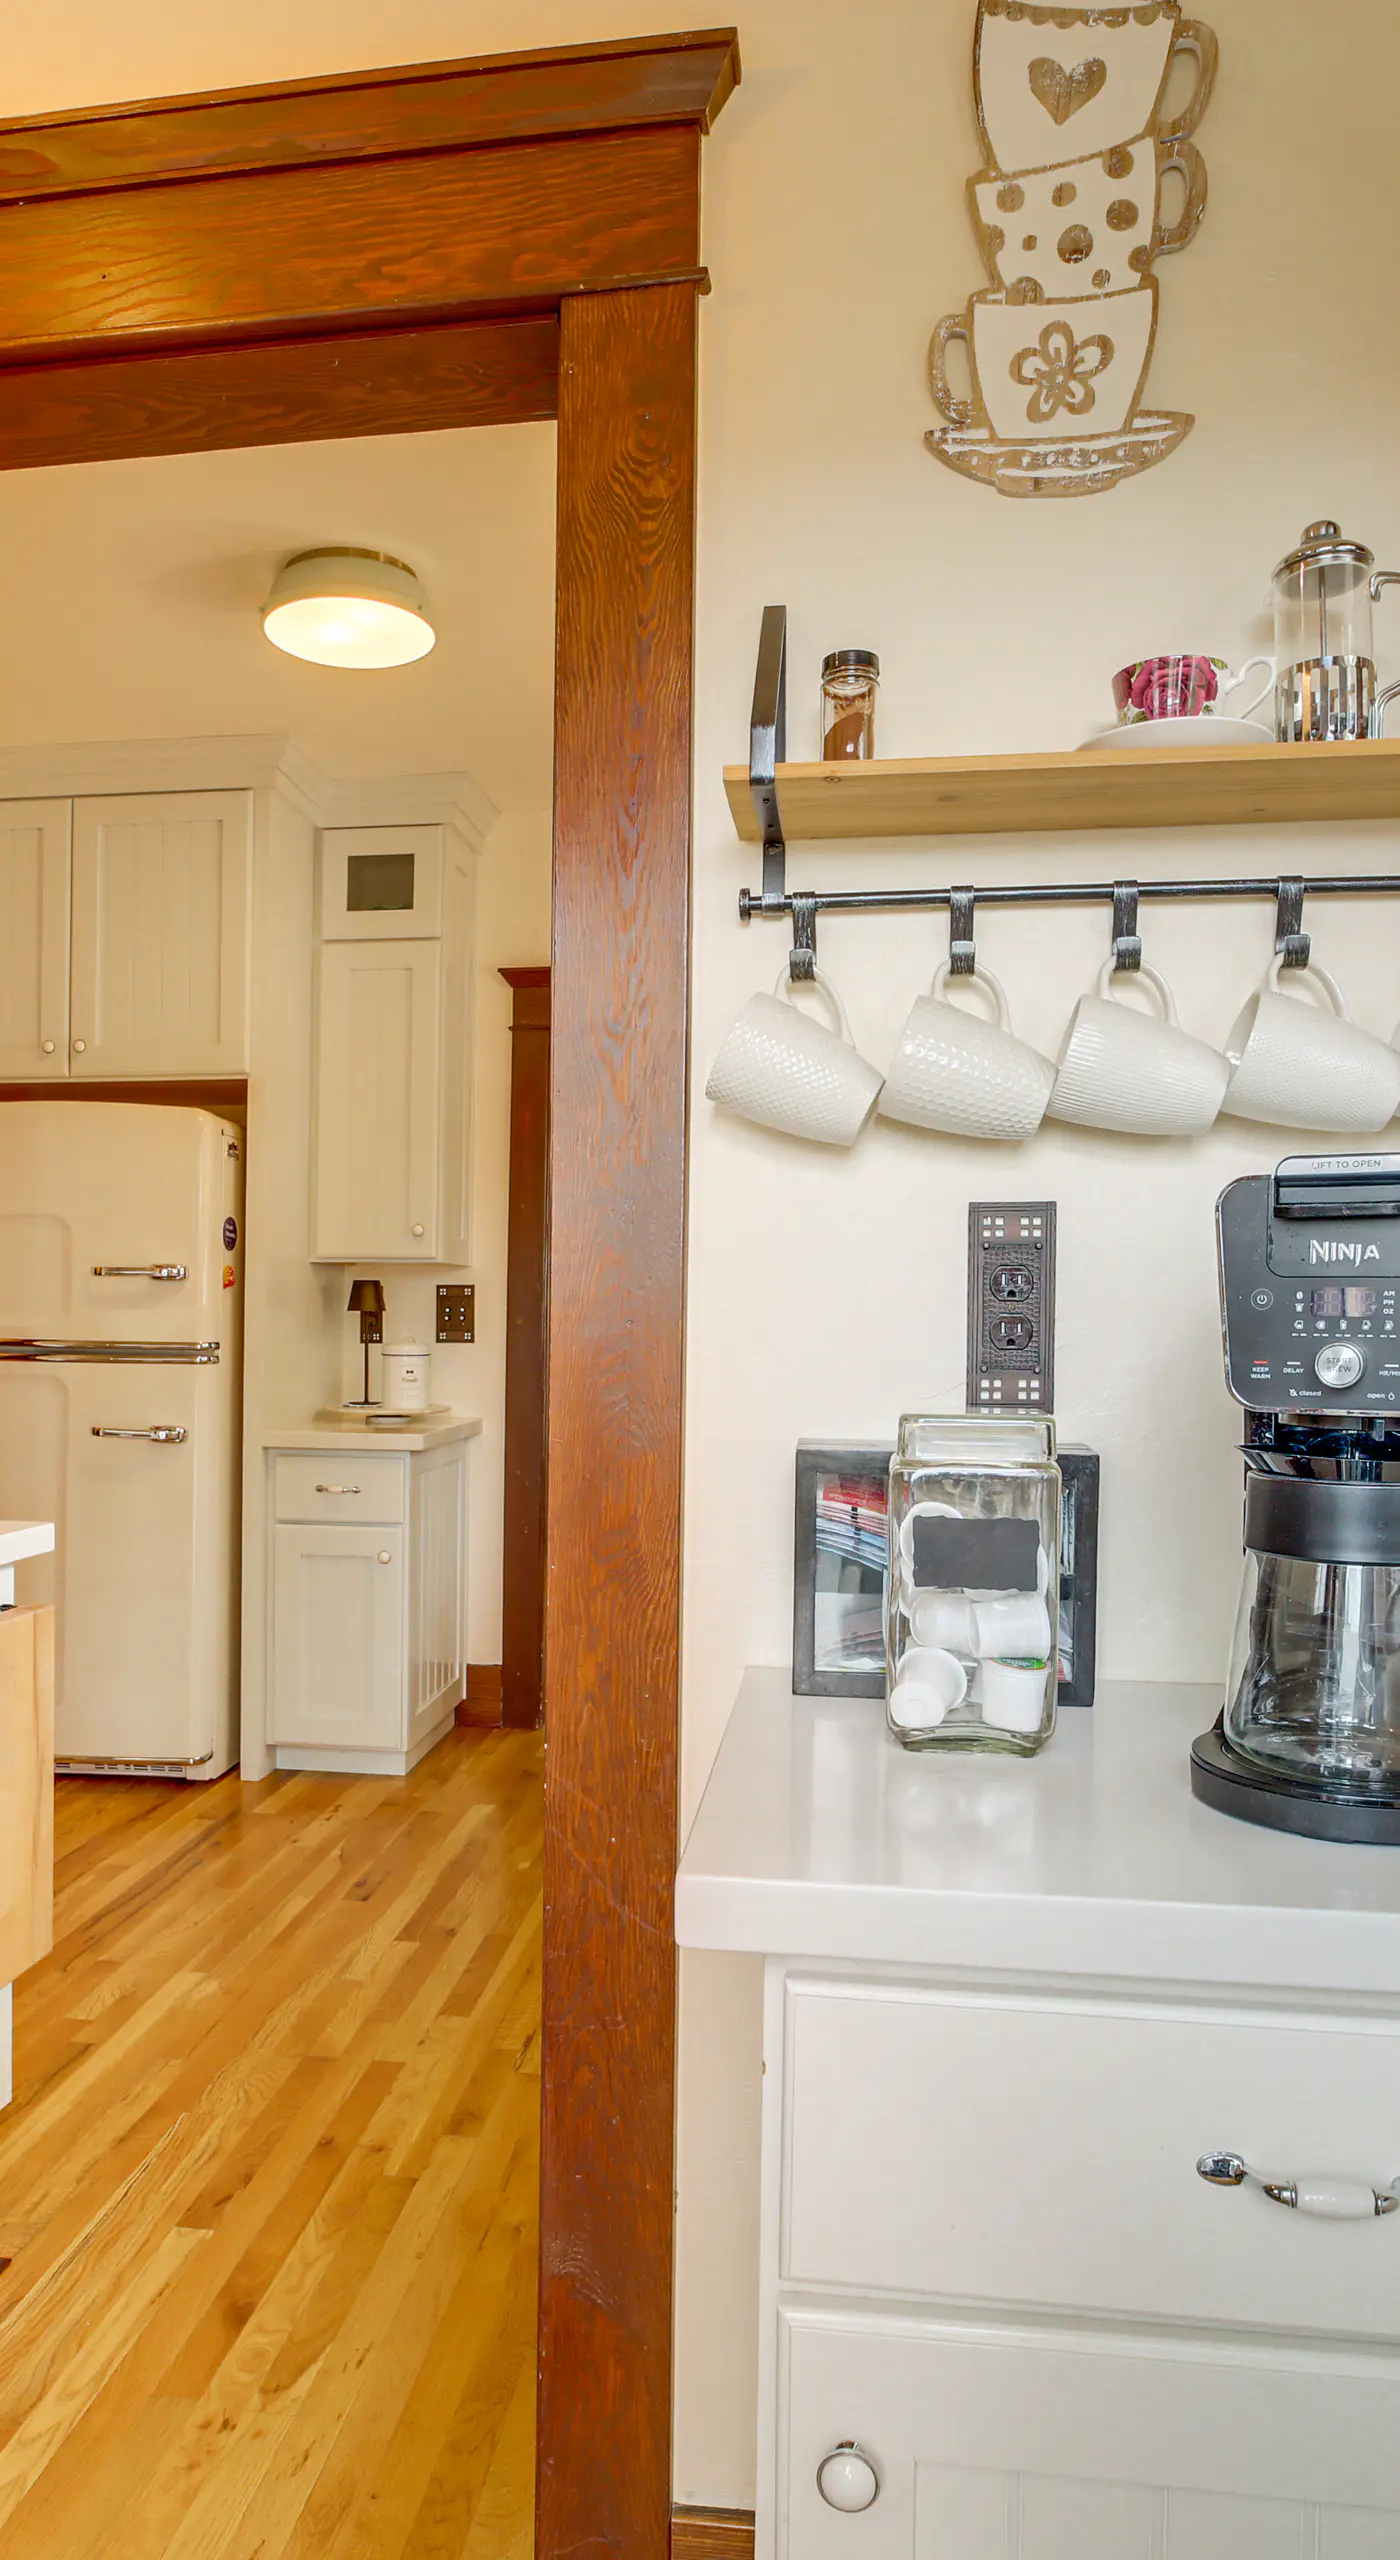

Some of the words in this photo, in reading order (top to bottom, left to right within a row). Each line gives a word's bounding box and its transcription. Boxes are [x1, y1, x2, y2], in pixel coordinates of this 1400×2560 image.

[1311, 1161, 1333, 1170] LIFT
[1336, 1160, 1349, 1169] TO
[1352, 1159, 1381, 1168] OPEN
[1309, 1239, 1380, 1268] NINJA
[1326, 1357, 1353, 1365] START
[1326, 1365, 1352, 1373] BREW
[1299, 1389, 1322, 1397] closed
[1367, 1392, 1386, 1400] open
